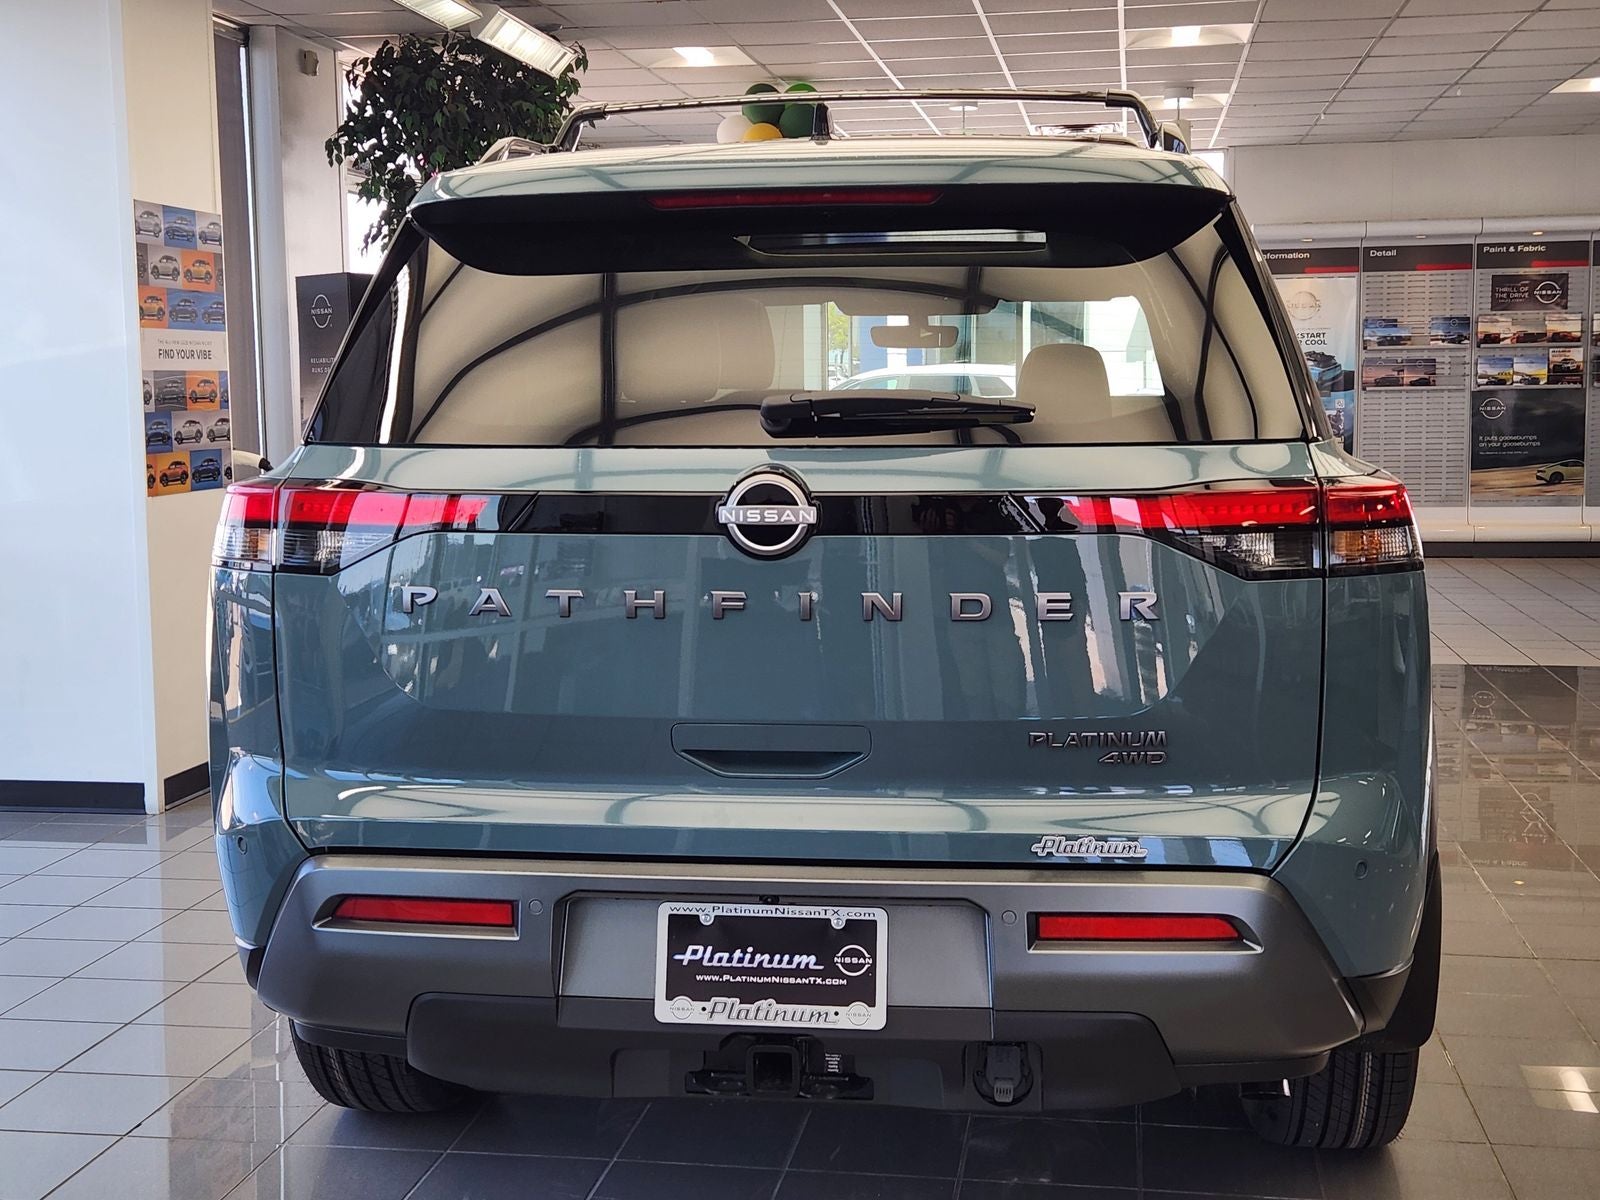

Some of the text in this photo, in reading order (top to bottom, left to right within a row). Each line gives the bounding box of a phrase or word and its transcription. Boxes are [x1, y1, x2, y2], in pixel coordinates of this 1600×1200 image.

[1262, 252, 1310, 260] nformation
[1483, 244, 1547, 253] Paint & Fabric
[158, 348, 213, 360] FIND YOUR VIBE
[719, 506, 817, 526] NISSAN
[400, 585, 1160, 622] PATHFINDER
[1029, 730, 1167, 748] PLATINUM
[1098, 751, 1167, 765] 4WD
[1031, 835, 1148, 858] Platinum
[669, 905, 876, 918] www.PlatinumNissanTX.com
[673, 944, 825, 970] Platinum
[833, 955, 873, 965] NISSAN
[707, 998, 839, 1025] Platinum
